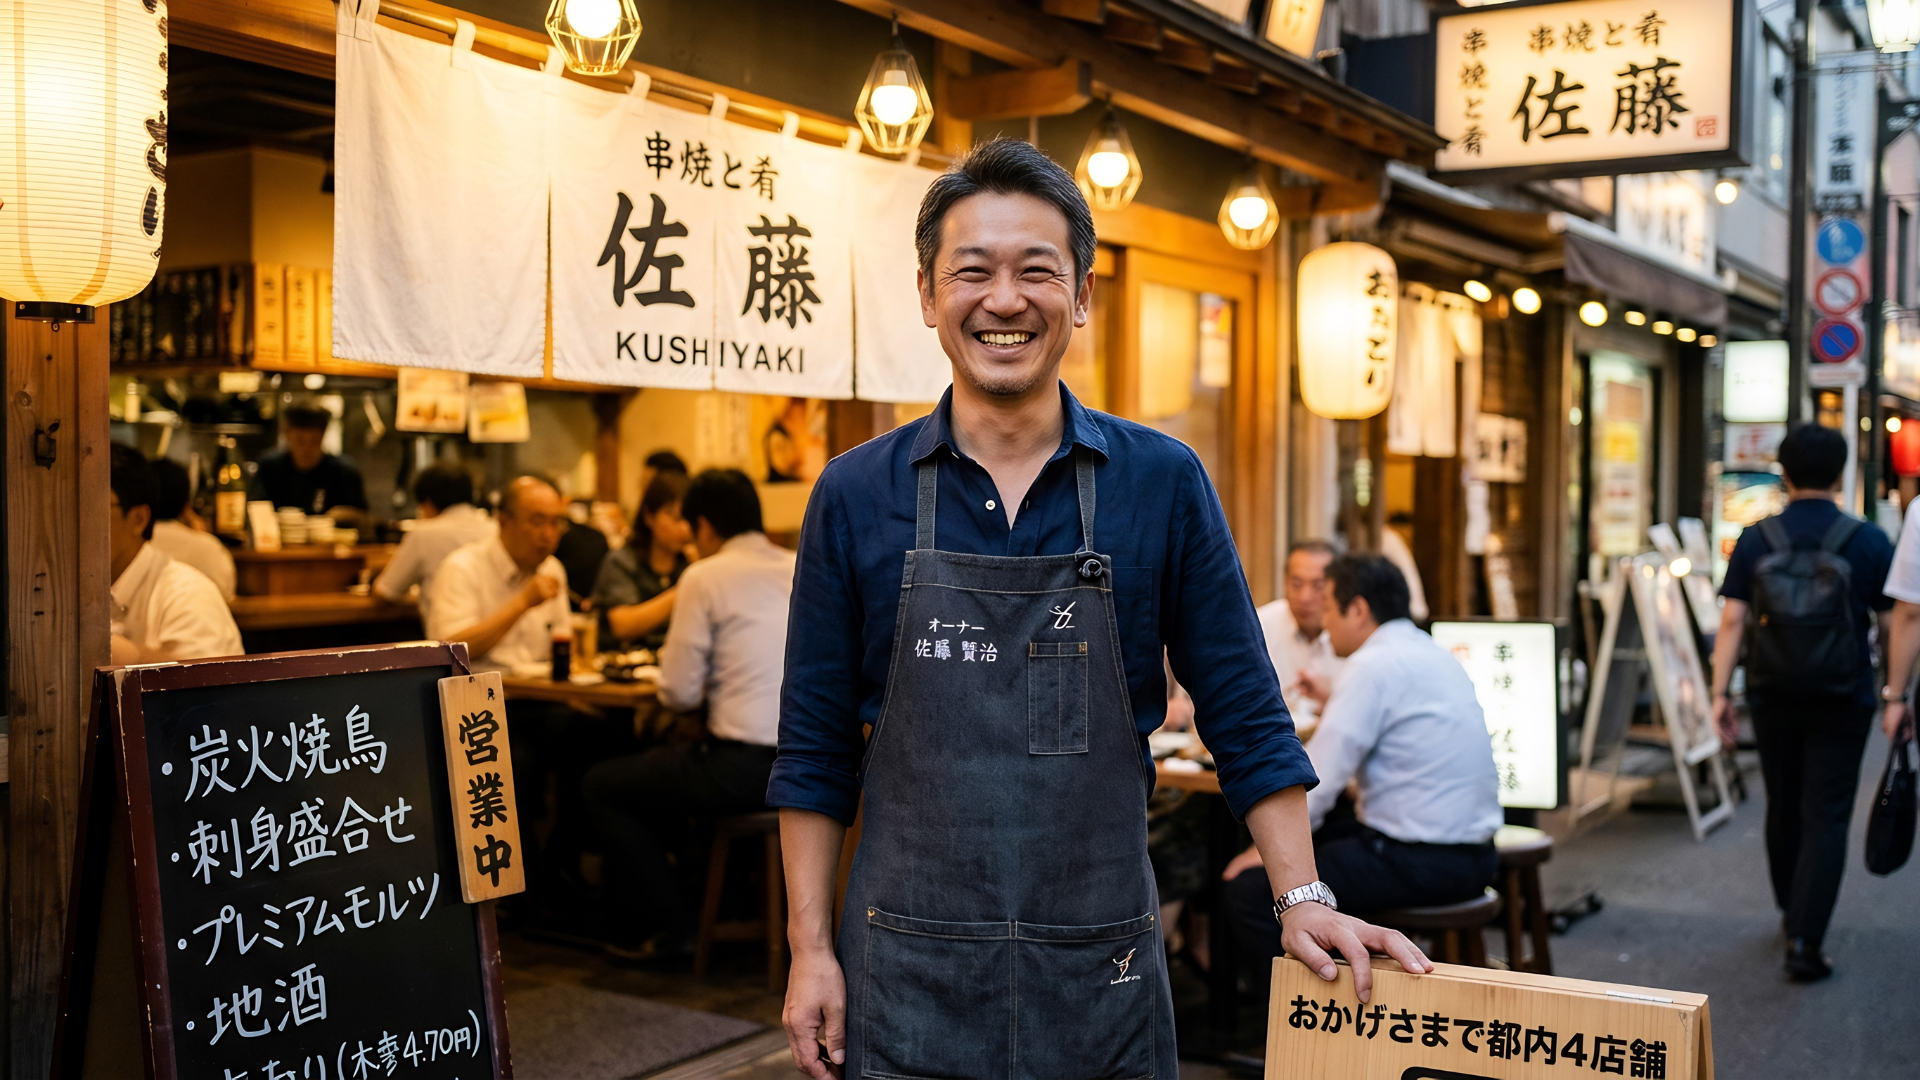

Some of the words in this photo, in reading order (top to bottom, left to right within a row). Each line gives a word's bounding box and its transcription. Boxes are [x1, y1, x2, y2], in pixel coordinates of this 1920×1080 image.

[1512, 57, 1689, 143] 佐藤
[644, 131, 780, 201] 串焼と肴
[597, 192, 822, 329] 佐藤
[616, 331, 804, 373] KUSHIYAKI
[928, 617, 986, 635] オーナー
[458, 709, 513, 888] 営業中
[1288, 994, 1667, 1080] おかげさまで都内4店舗
